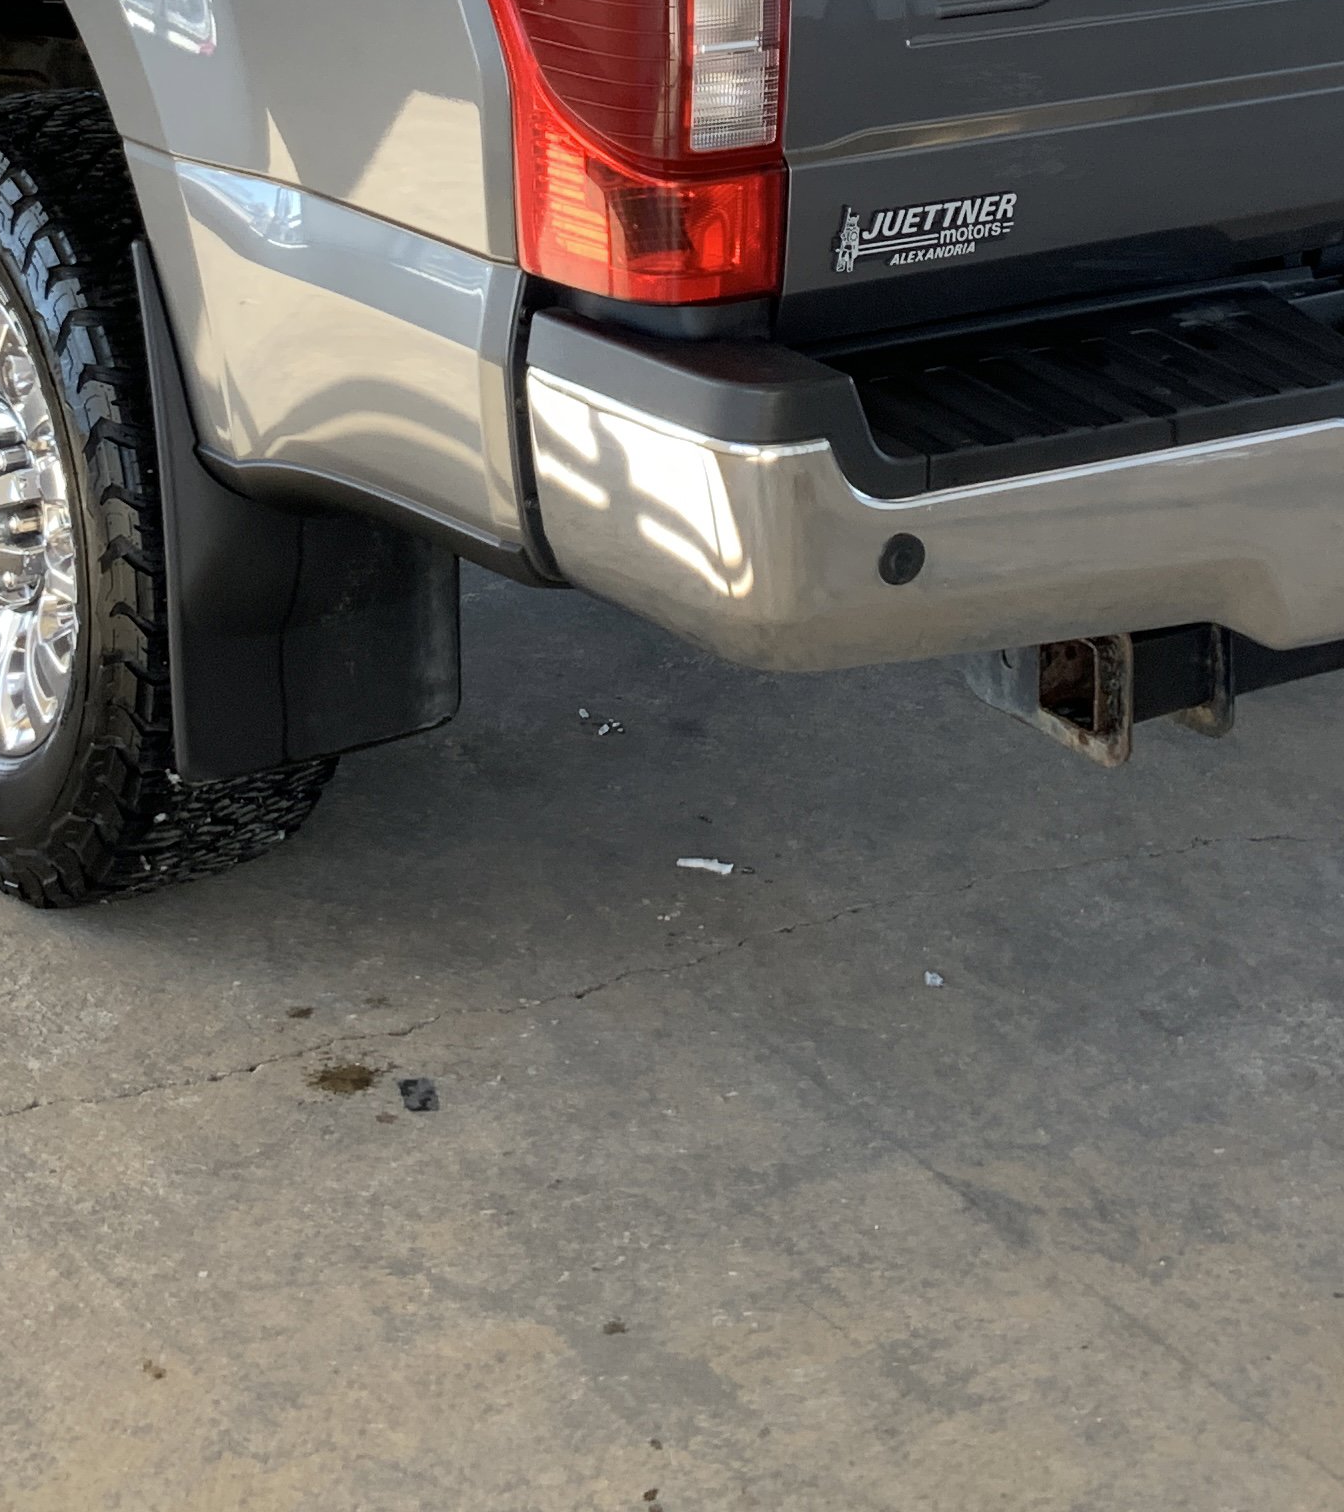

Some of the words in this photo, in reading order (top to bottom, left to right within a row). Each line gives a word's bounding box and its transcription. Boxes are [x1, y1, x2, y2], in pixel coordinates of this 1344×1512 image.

[862, 192, 1018, 240] JUETTNER
[939, 221, 1001, 245] motors
[889, 241, 976, 266] ALEXANDRIA
